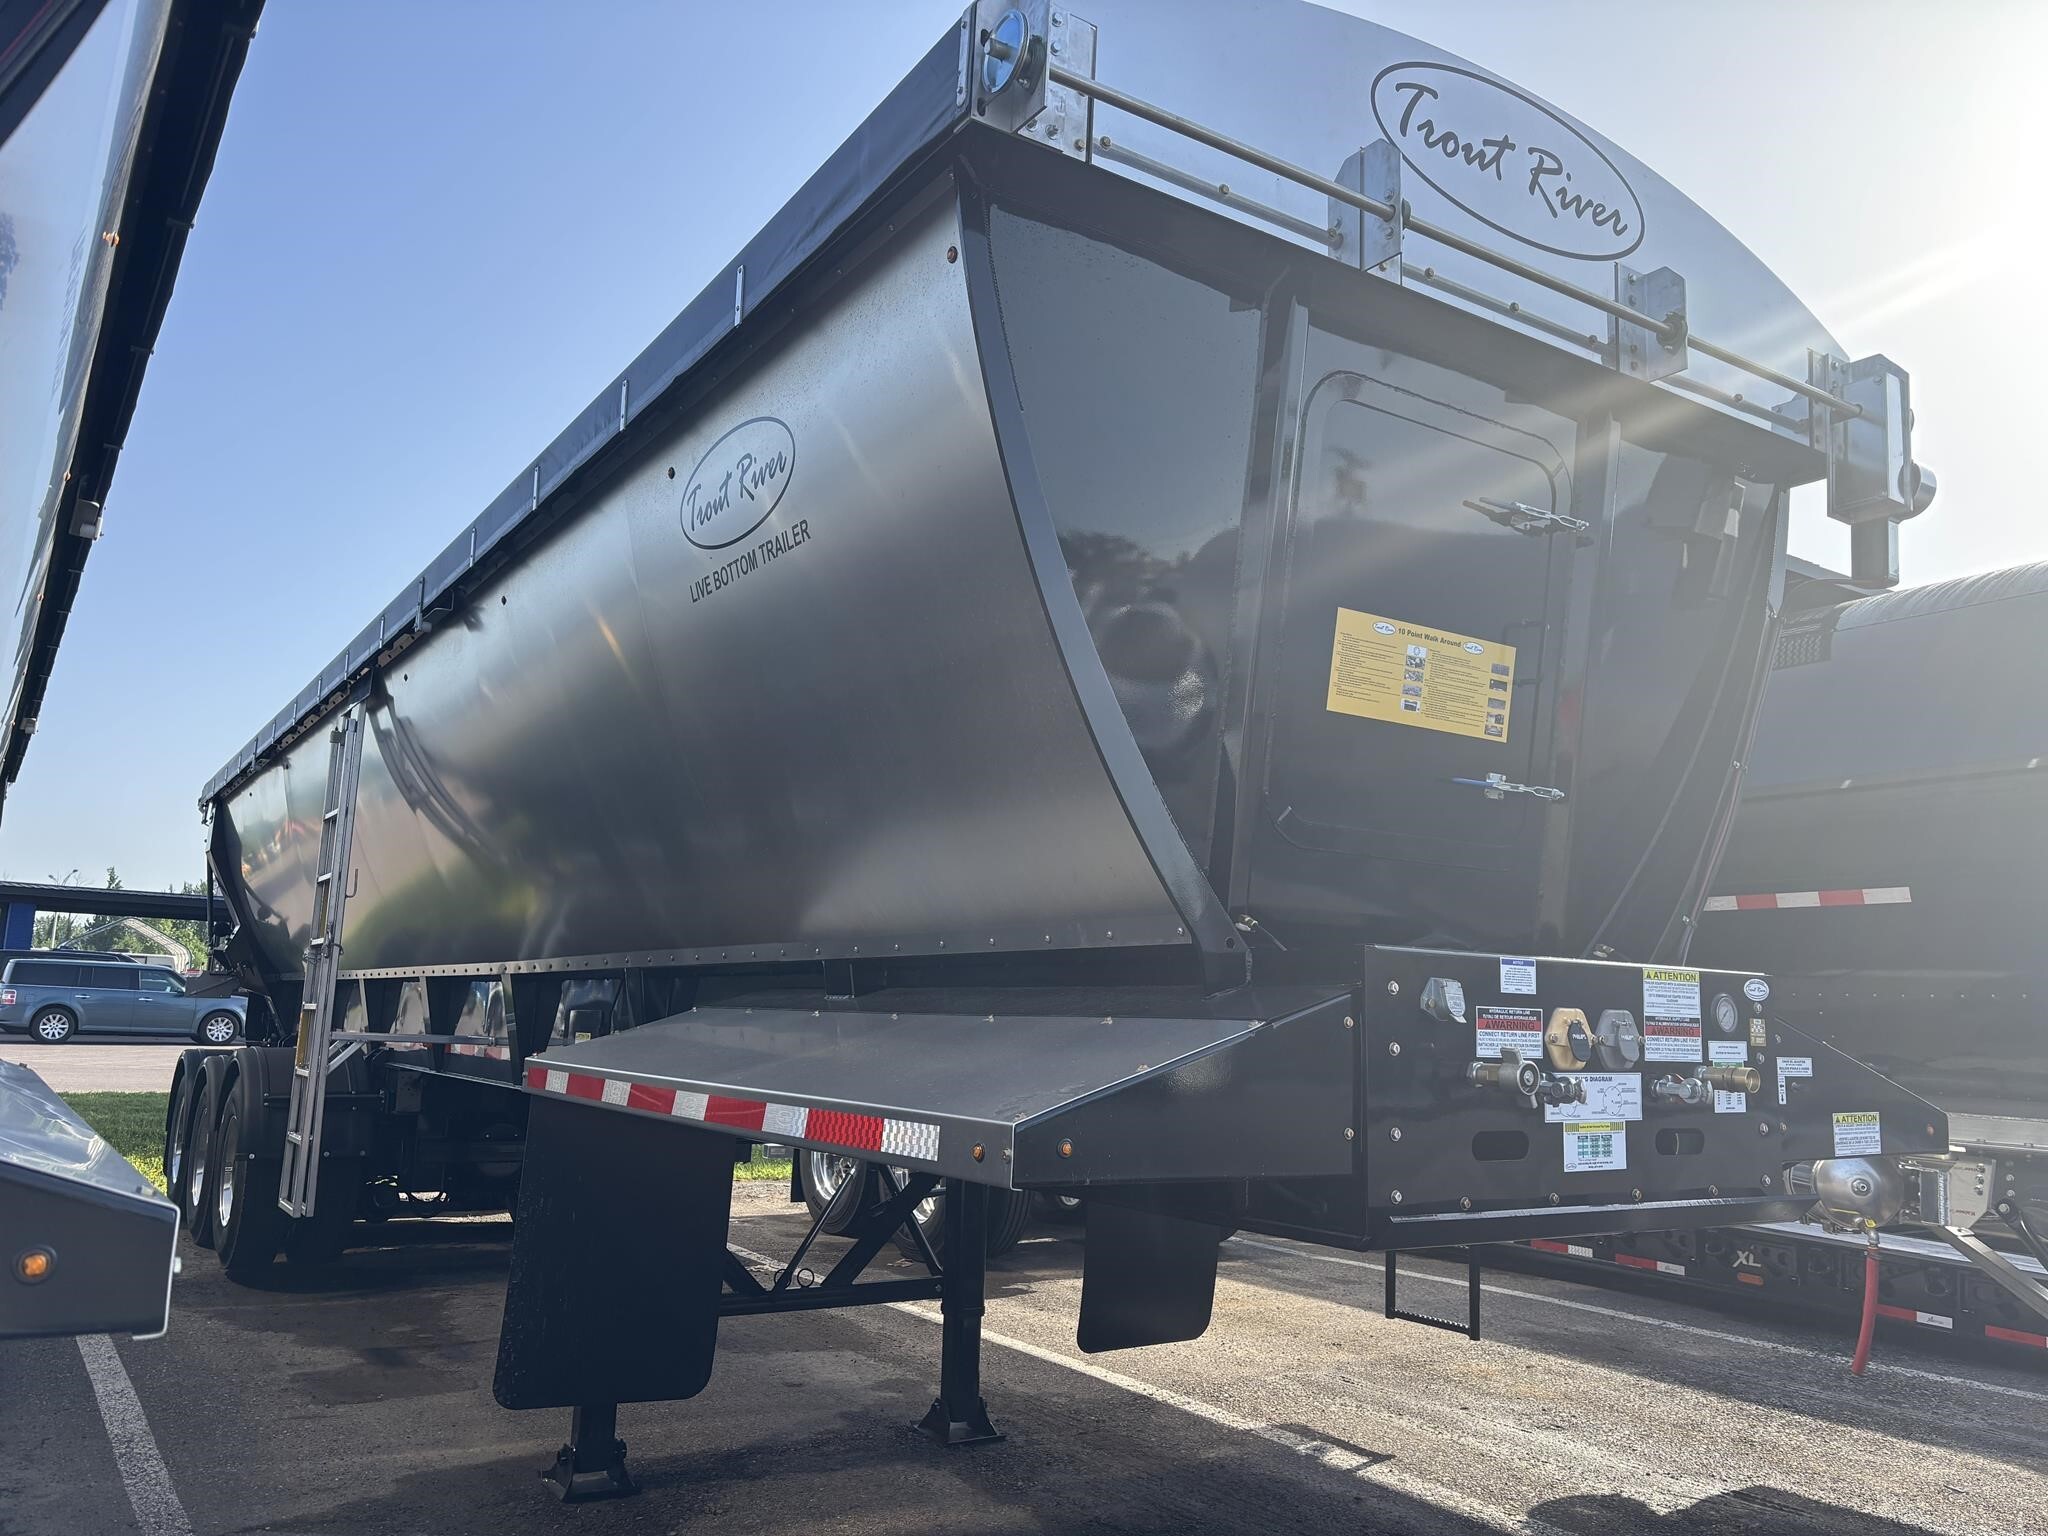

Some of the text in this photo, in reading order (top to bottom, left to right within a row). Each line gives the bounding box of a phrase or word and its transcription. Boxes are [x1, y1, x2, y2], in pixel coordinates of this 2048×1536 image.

[1395, 82, 1628, 236] Trout River
[687, 451, 787, 532] Trout River
[689, 519, 811, 603] LIVE BOTTOM TRAILER
[1407, 629, 1423, 640] Point
[1424, 633, 1439, 643] Walk
[1440, 637, 1462, 648] Around
[1653, 971, 1697, 982] ATTENTION
[1490, 1020, 1535, 1030] WARNING
[1654, 1026, 1694, 1036] WARNING
[1841, 1114, 1877, 1123] ATTENTION
[1732, 1250, 1761, 1268] XL
